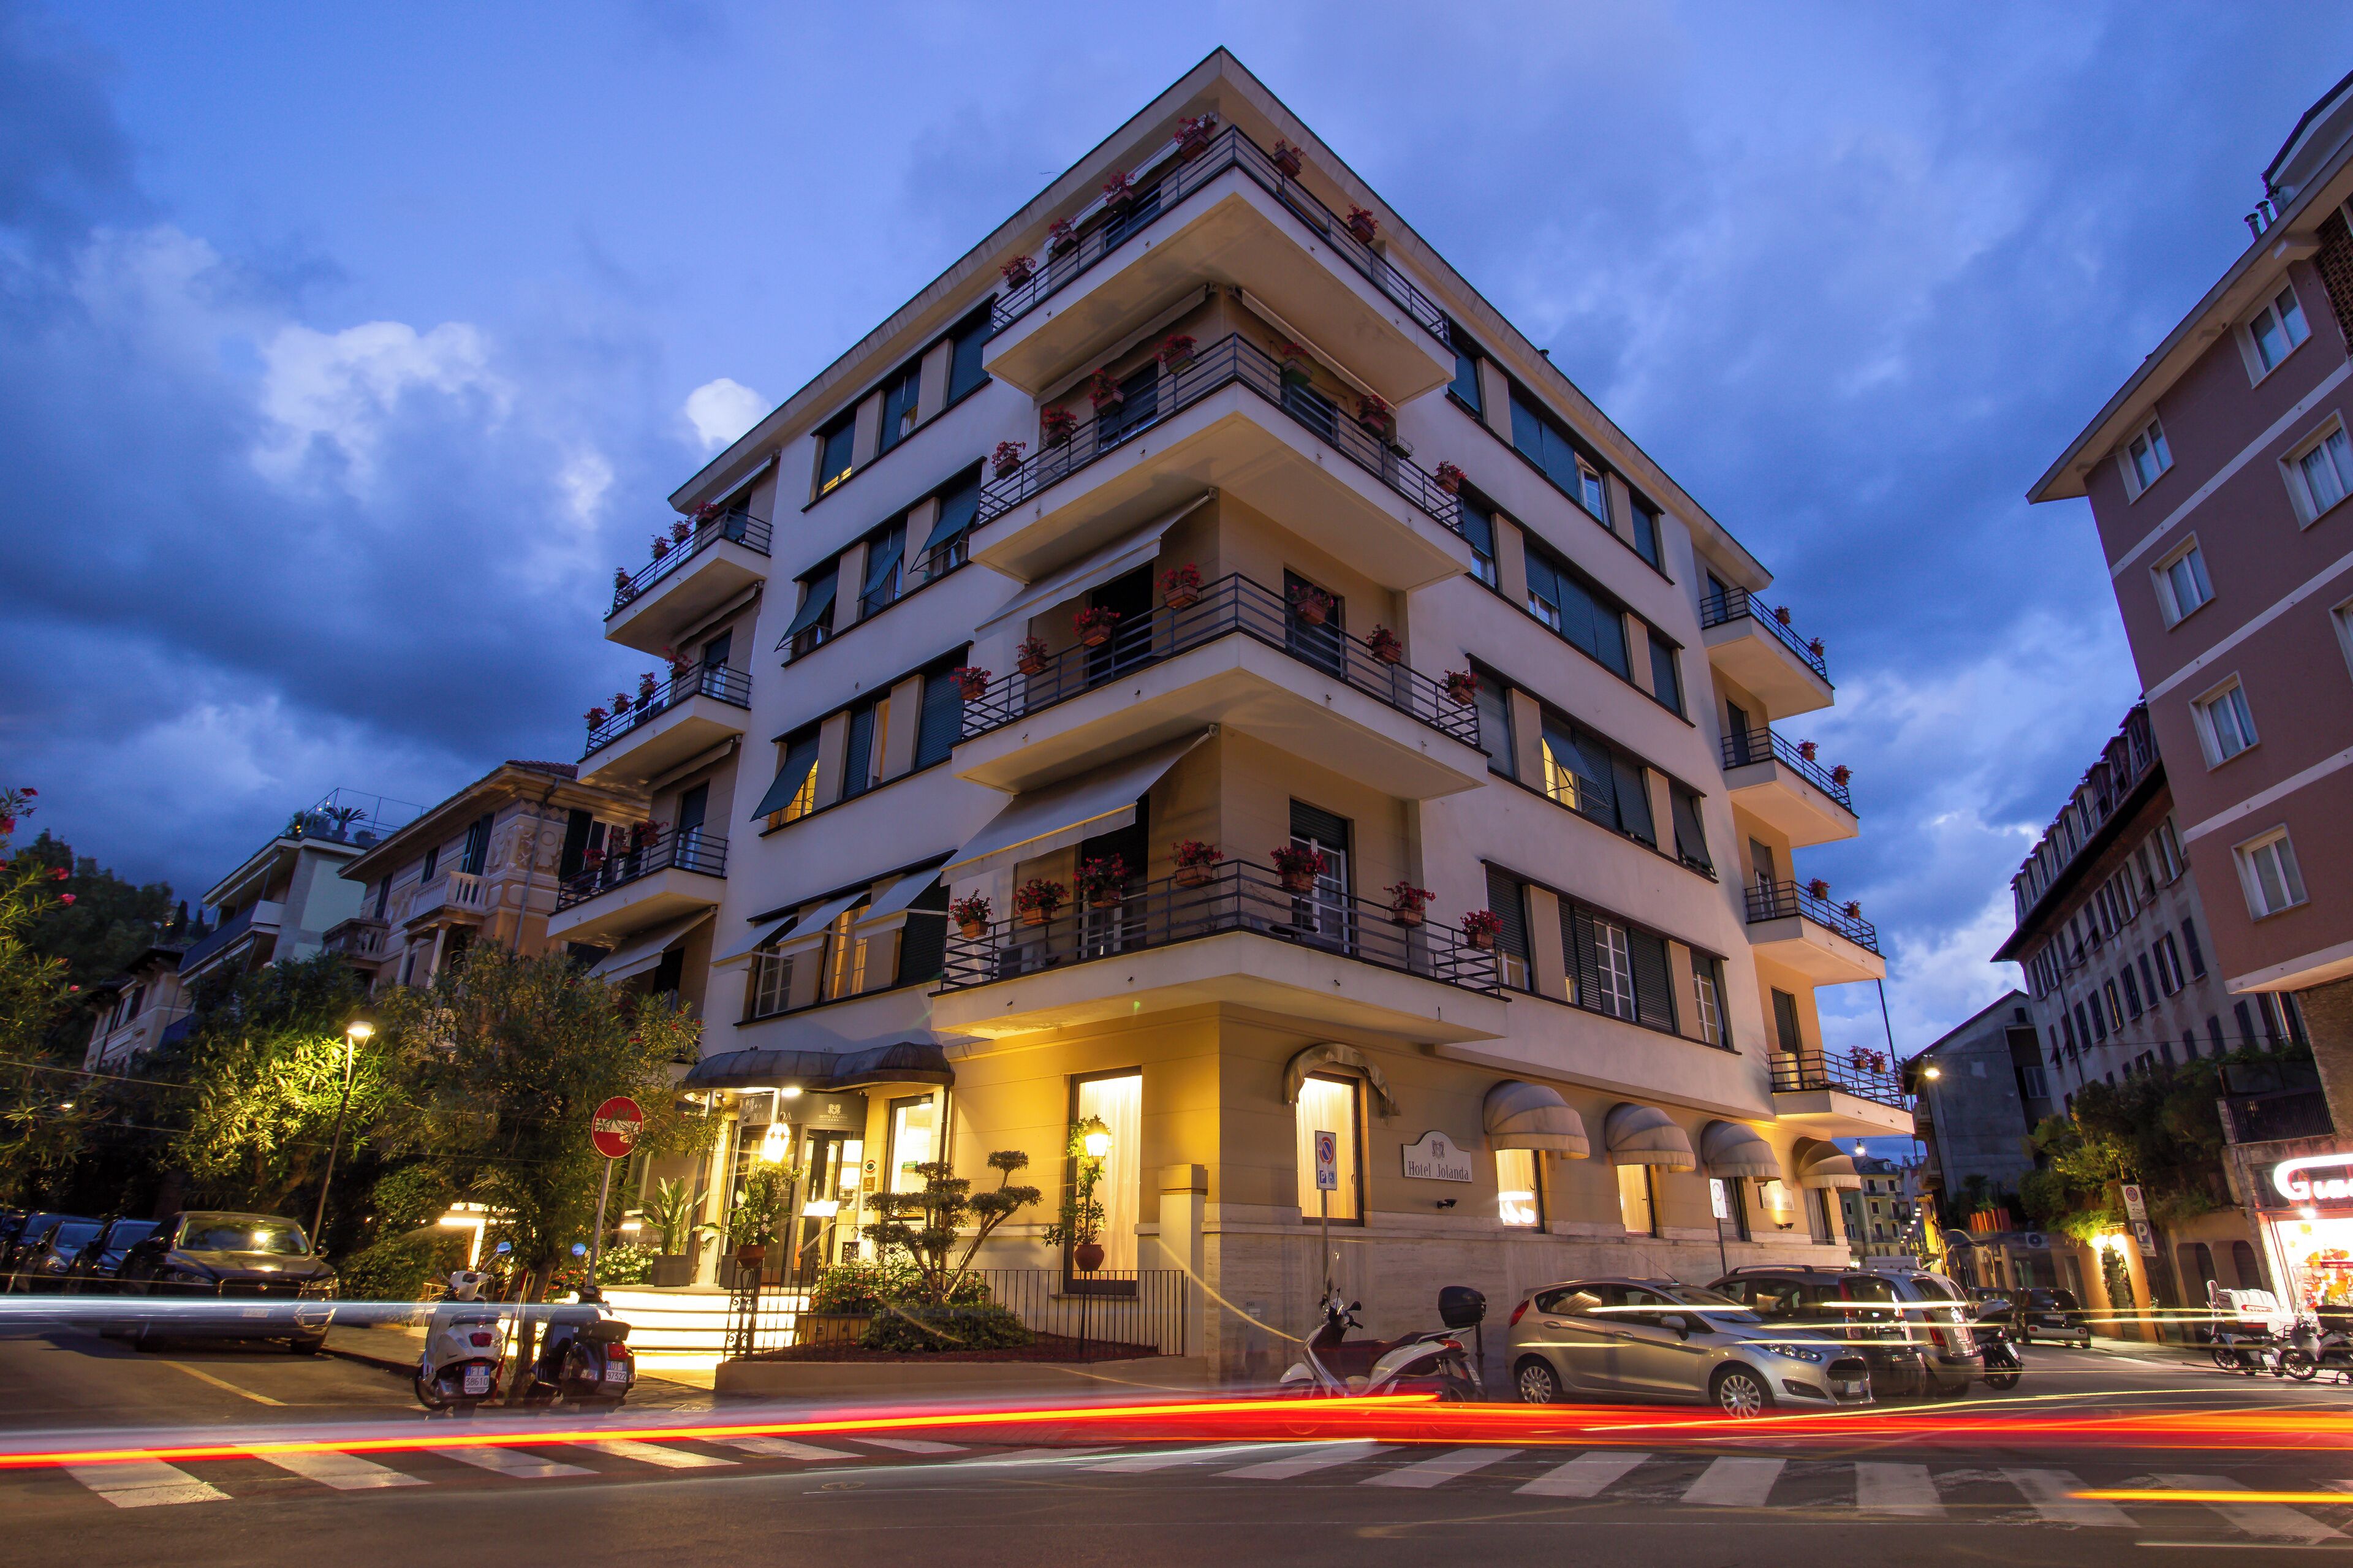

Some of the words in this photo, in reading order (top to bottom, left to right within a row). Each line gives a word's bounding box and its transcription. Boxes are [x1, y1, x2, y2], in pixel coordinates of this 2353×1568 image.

[752, 1111, 792, 1123] JOLADA
[1408, 1161, 1431, 1177] Hotel
[1436, 1163, 1469, 1180] Jolanda
[2135, 1222, 2148, 1242] P
[466, 1377, 488, 1386] 38610
[607, 1371, 626, 1381] 97322
